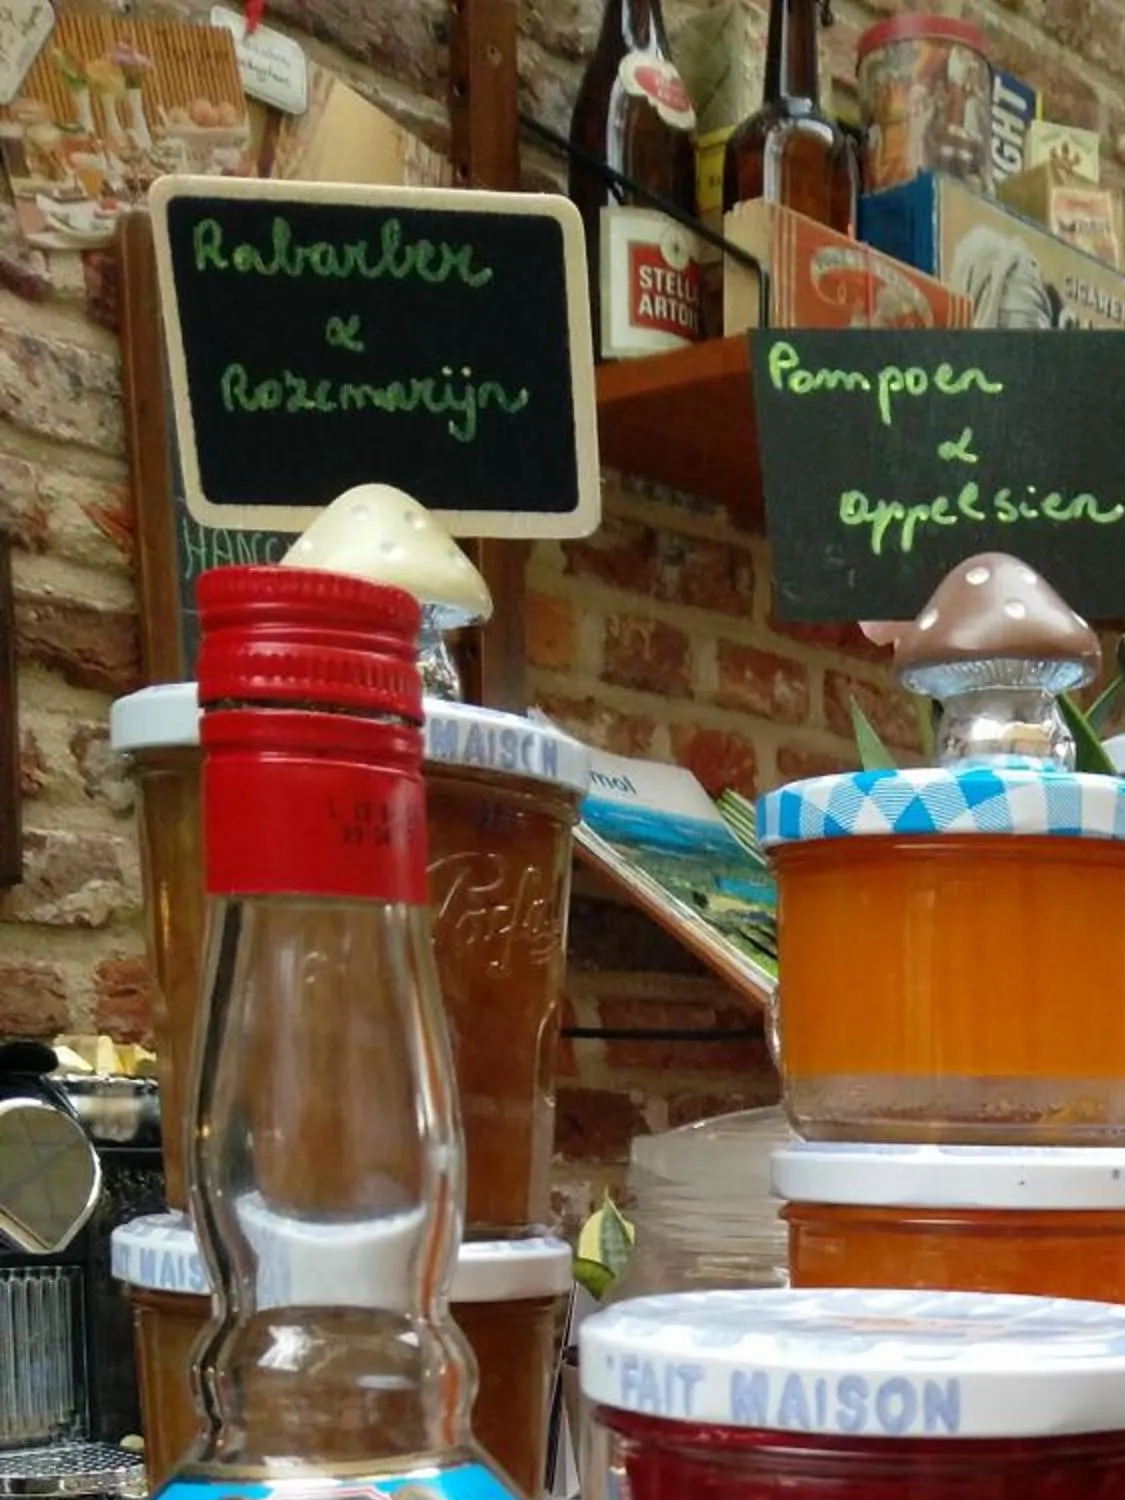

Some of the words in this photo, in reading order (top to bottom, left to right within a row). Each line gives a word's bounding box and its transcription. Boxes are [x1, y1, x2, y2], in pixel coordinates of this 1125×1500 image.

[430, 718, 560, 778] MAISON
[620, 1352, 705, 1416] FAIT
[731, 1368, 962, 1434] MAISON
